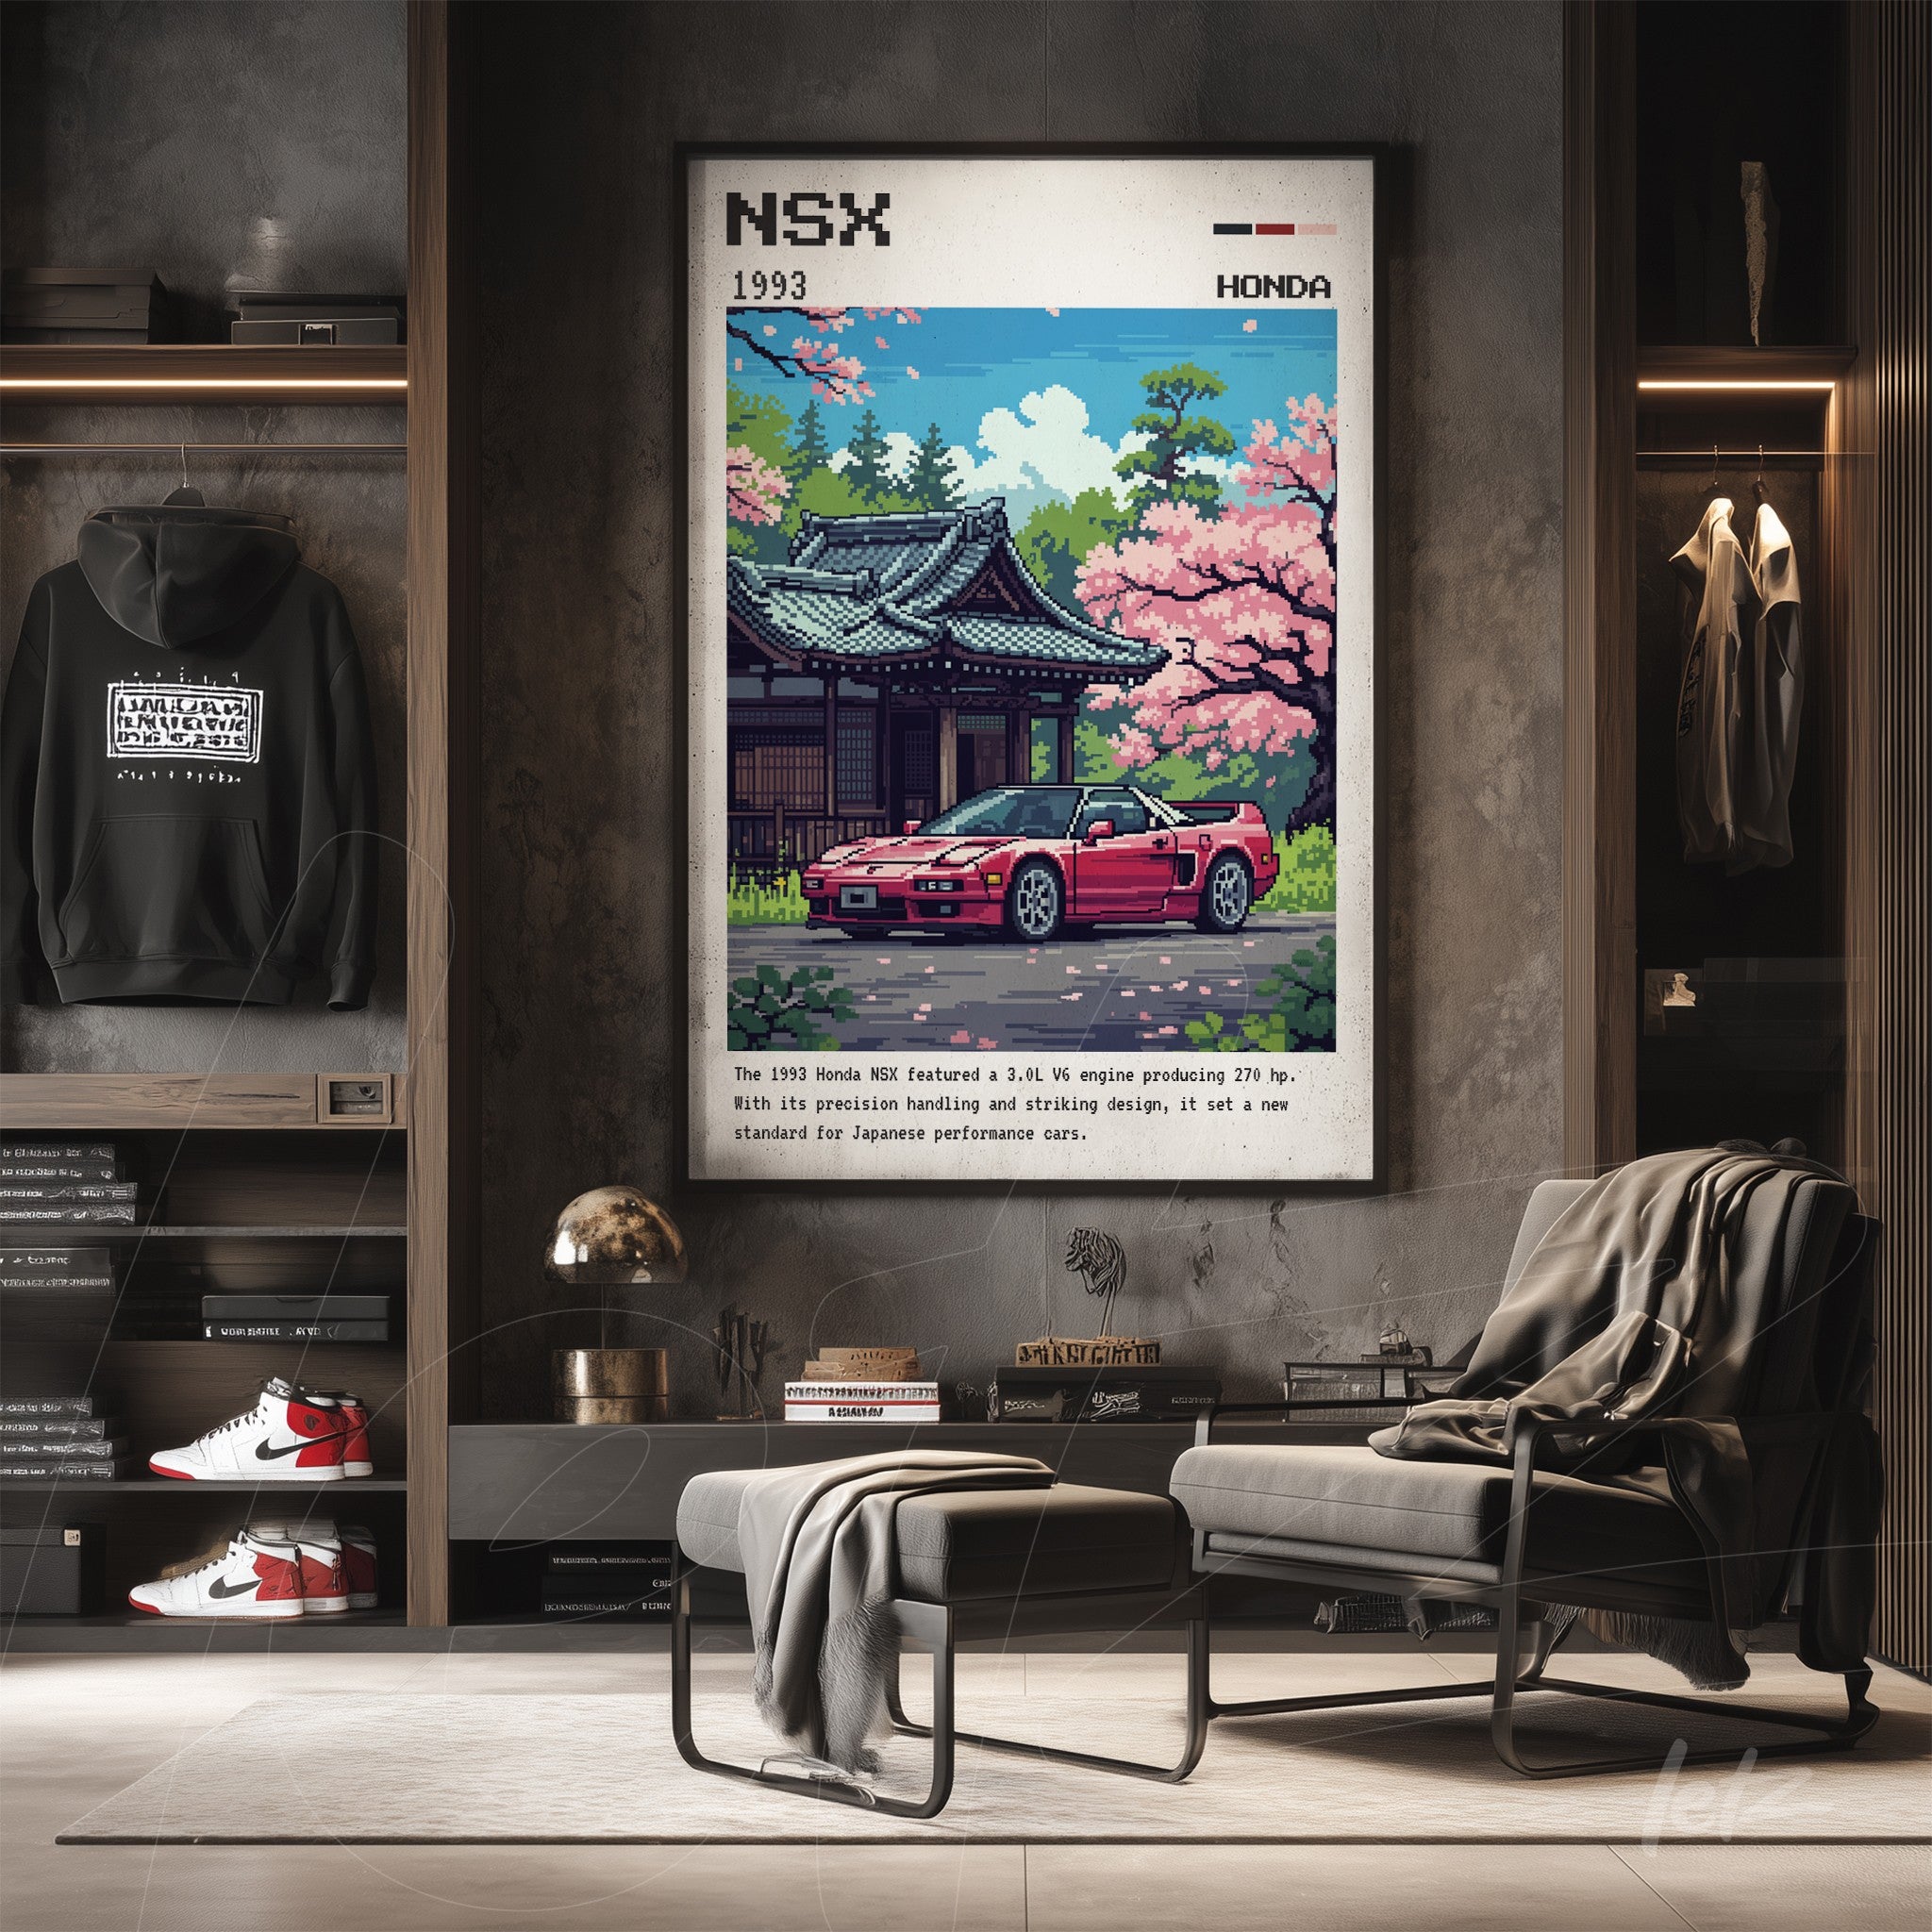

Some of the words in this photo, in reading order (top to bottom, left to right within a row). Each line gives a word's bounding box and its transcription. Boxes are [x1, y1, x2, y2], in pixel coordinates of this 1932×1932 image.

[726, 192, 890, 246] NSX
[733, 270, 807, 301] 1993
[1217, 275, 1331, 299] HONDA
[734, 1066, 761, 1081] The
[771, 1066, 807, 1081] 1993
[816, 1066, 861, 1081] Honda
[871, 1066, 898, 1081] NSX
[908, 1066, 980, 1082] featured
[989, 1071, 998, 1082] a
[1008, 1067, 1043, 1082] 3.0L
[1052, 1067, 1070, 1082] V6
[1079, 1067, 1134, 1086] engine
[1143, 1067, 1224, 1086] producing
[1234, 1067, 1261, 1082] 270
[1270, 1067, 1295, 1086] hp.
[734, 1095, 771, 1110] With
[780, 1095, 807, 1110] its
[816, 1095, 898, 1114] precision
[907, 1095, 980, 1115] handling
[989, 1096, 1016, 1111] and
[1025, 1096, 1098, 1115] striking
[1107, 1096, 1169, 1115] design,
[1180, 1096, 1197, 1111] it
[1207, 1096, 1233, 1111] set
[1242, 1100, 1253, 1111] a
[1261, 1100, 1289, 1111] new
[734, 1124, 808, 1140] standard
[817, 1124, 843, 1140] for
[852, 1124, 925, 1143] Japanese
[934, 1124, 1035, 1144] performance
[1043, 1128, 1087, 1141] cars.
